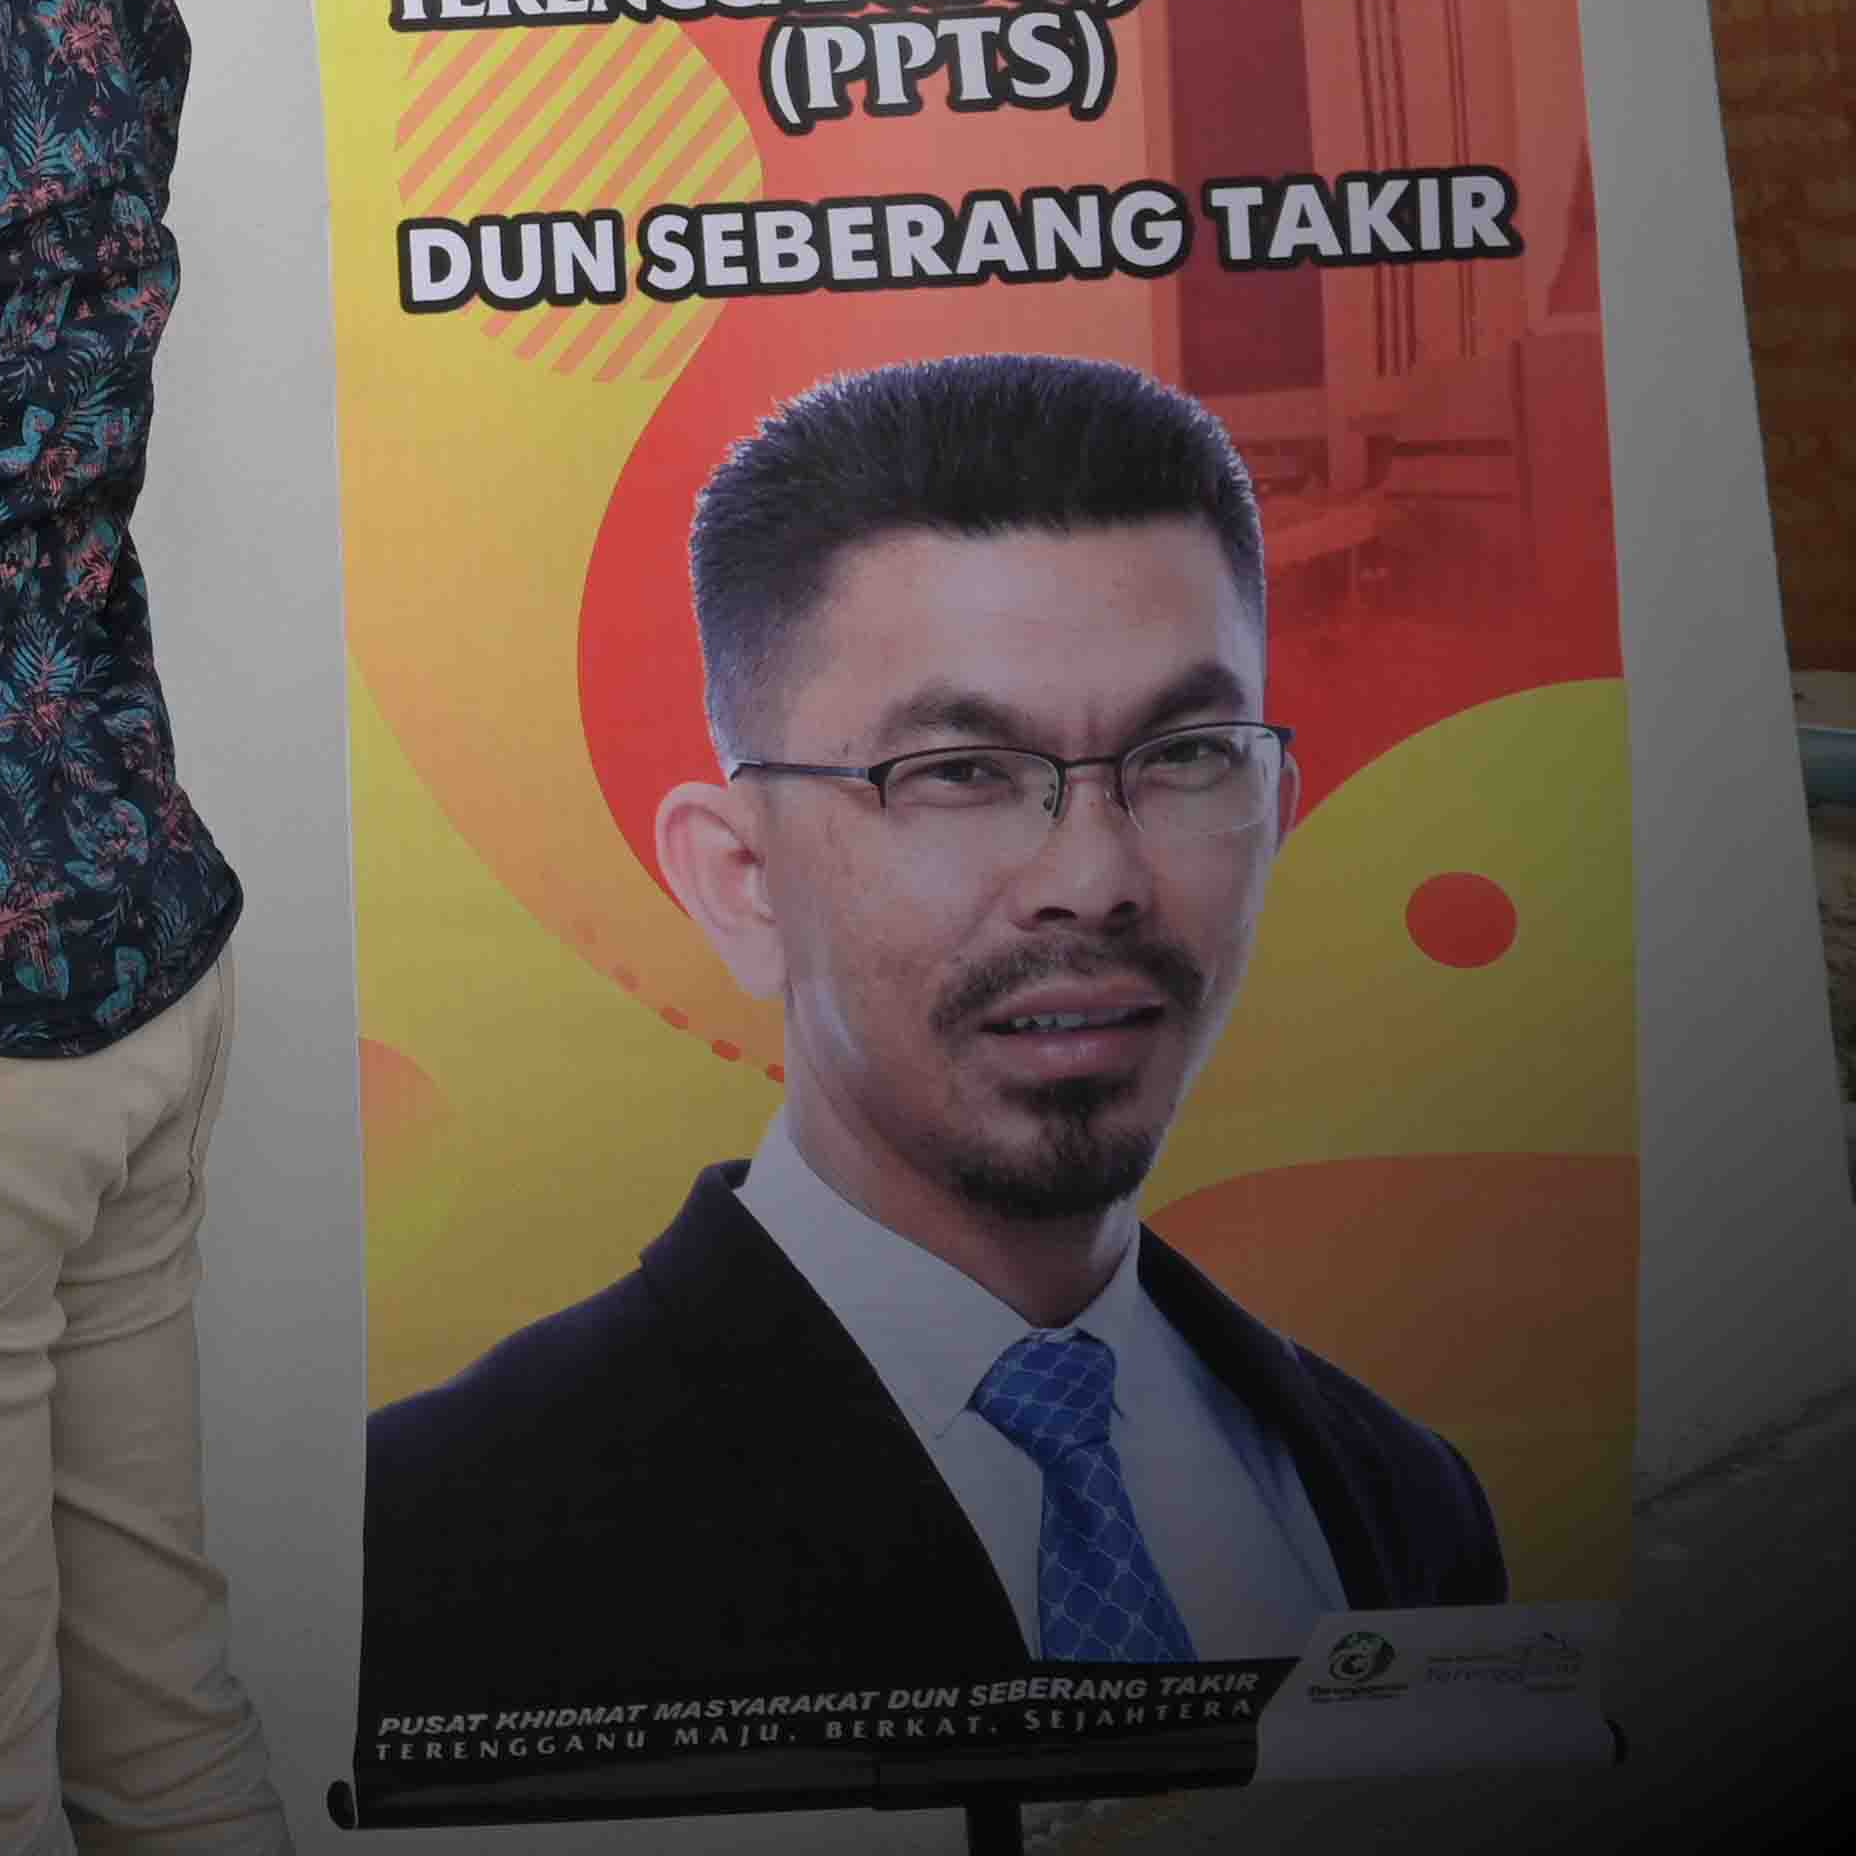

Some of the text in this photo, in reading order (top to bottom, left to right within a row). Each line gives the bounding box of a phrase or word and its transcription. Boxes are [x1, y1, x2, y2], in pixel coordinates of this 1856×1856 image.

[768, 7, 1107, 126] (PPTS)
[406, 173, 1512, 304] DUN SEBERANG TAKIR
[375, 1698, 1255, 1761] TERENGGANU MAJU. BERKAT. SEJAHTERA
[377, 1672, 1260, 1737] PUSAT KHIDMAT MASYARAKAT DUN SEBERANG TAKIR
